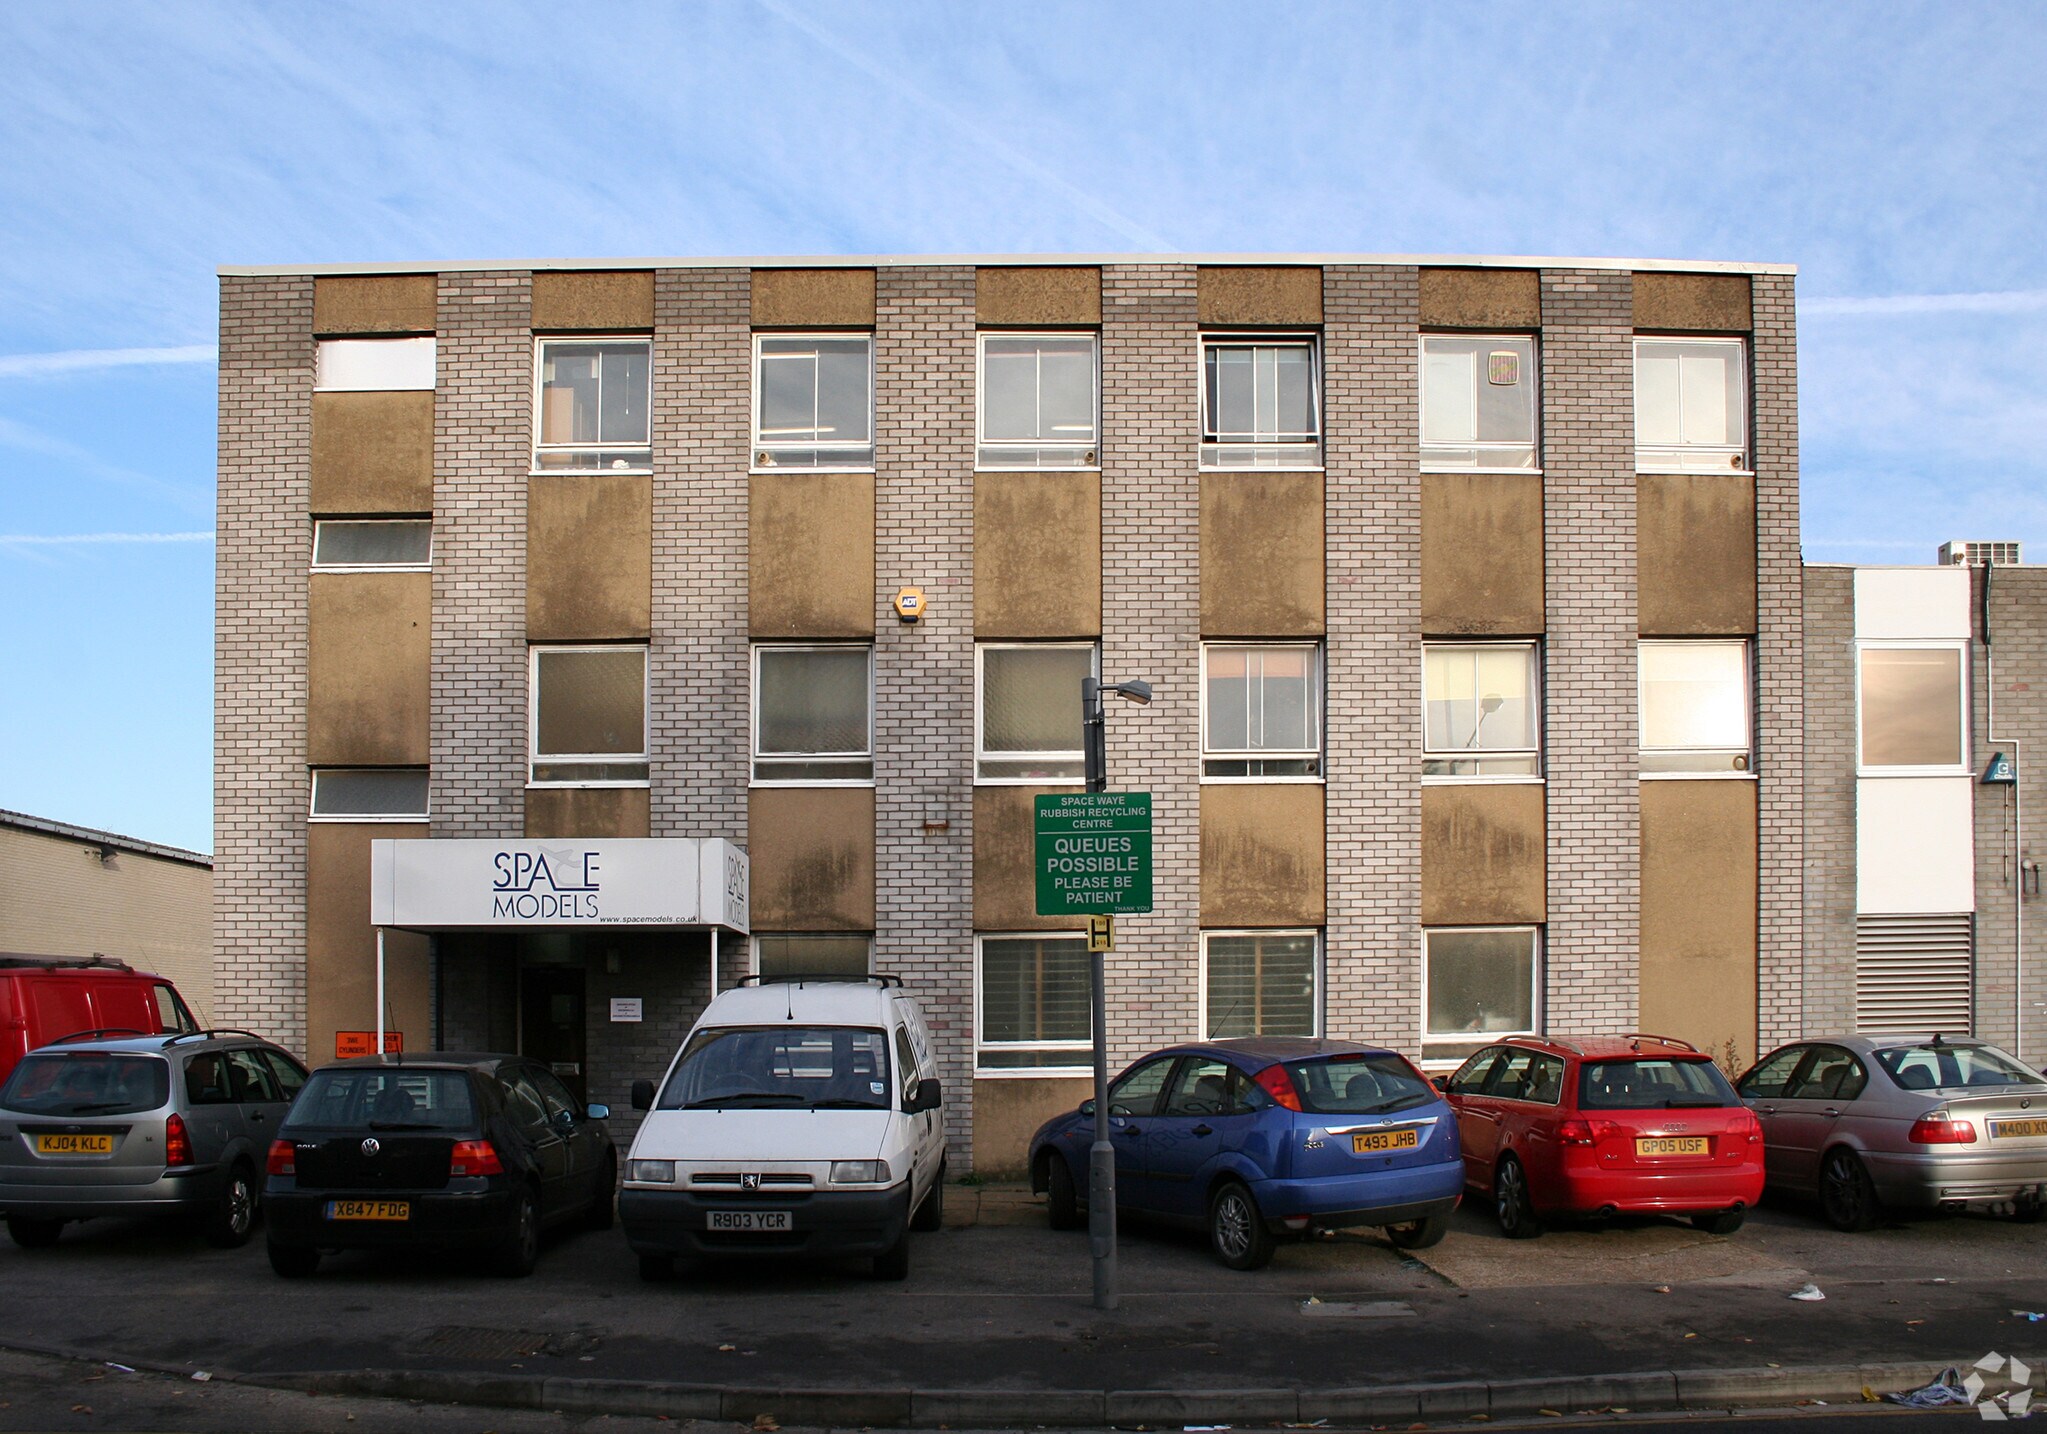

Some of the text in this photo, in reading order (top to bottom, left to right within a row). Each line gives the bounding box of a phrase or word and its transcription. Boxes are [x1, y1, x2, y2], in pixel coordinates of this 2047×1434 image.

[902, 597, 917, 606] ADT
[1061, 795, 1125, 806] SPACE WAYE
[1040, 806, 1147, 818] RUBBISH RECYCLING
[1072, 819, 1114, 829] CENTRE
[1054, 837, 1132, 854] QUEUES
[493, 851, 600, 892] SPACE
[1047, 856, 1140, 873] POSSIBLE
[1054, 875, 1133, 889] PLEASE BE
[1066, 891, 1123, 904] PATIENT
[493, 893, 599, 919] MODELS
[600, 915, 698, 925] www.spacemodels.co.uk
[1091, 918, 1111, 948] H
[1998, 1121, 2031, 1136] M400
[44, 1136, 107, 1150] KJ04 KLC
[1355, 1132, 1416, 1151] T493 JHB
[1642, 1139, 1703, 1153] GP05 USF
[336, 1202, 408, 1217] X847 FDG
[713, 1213, 786, 1228] R903 YCR
